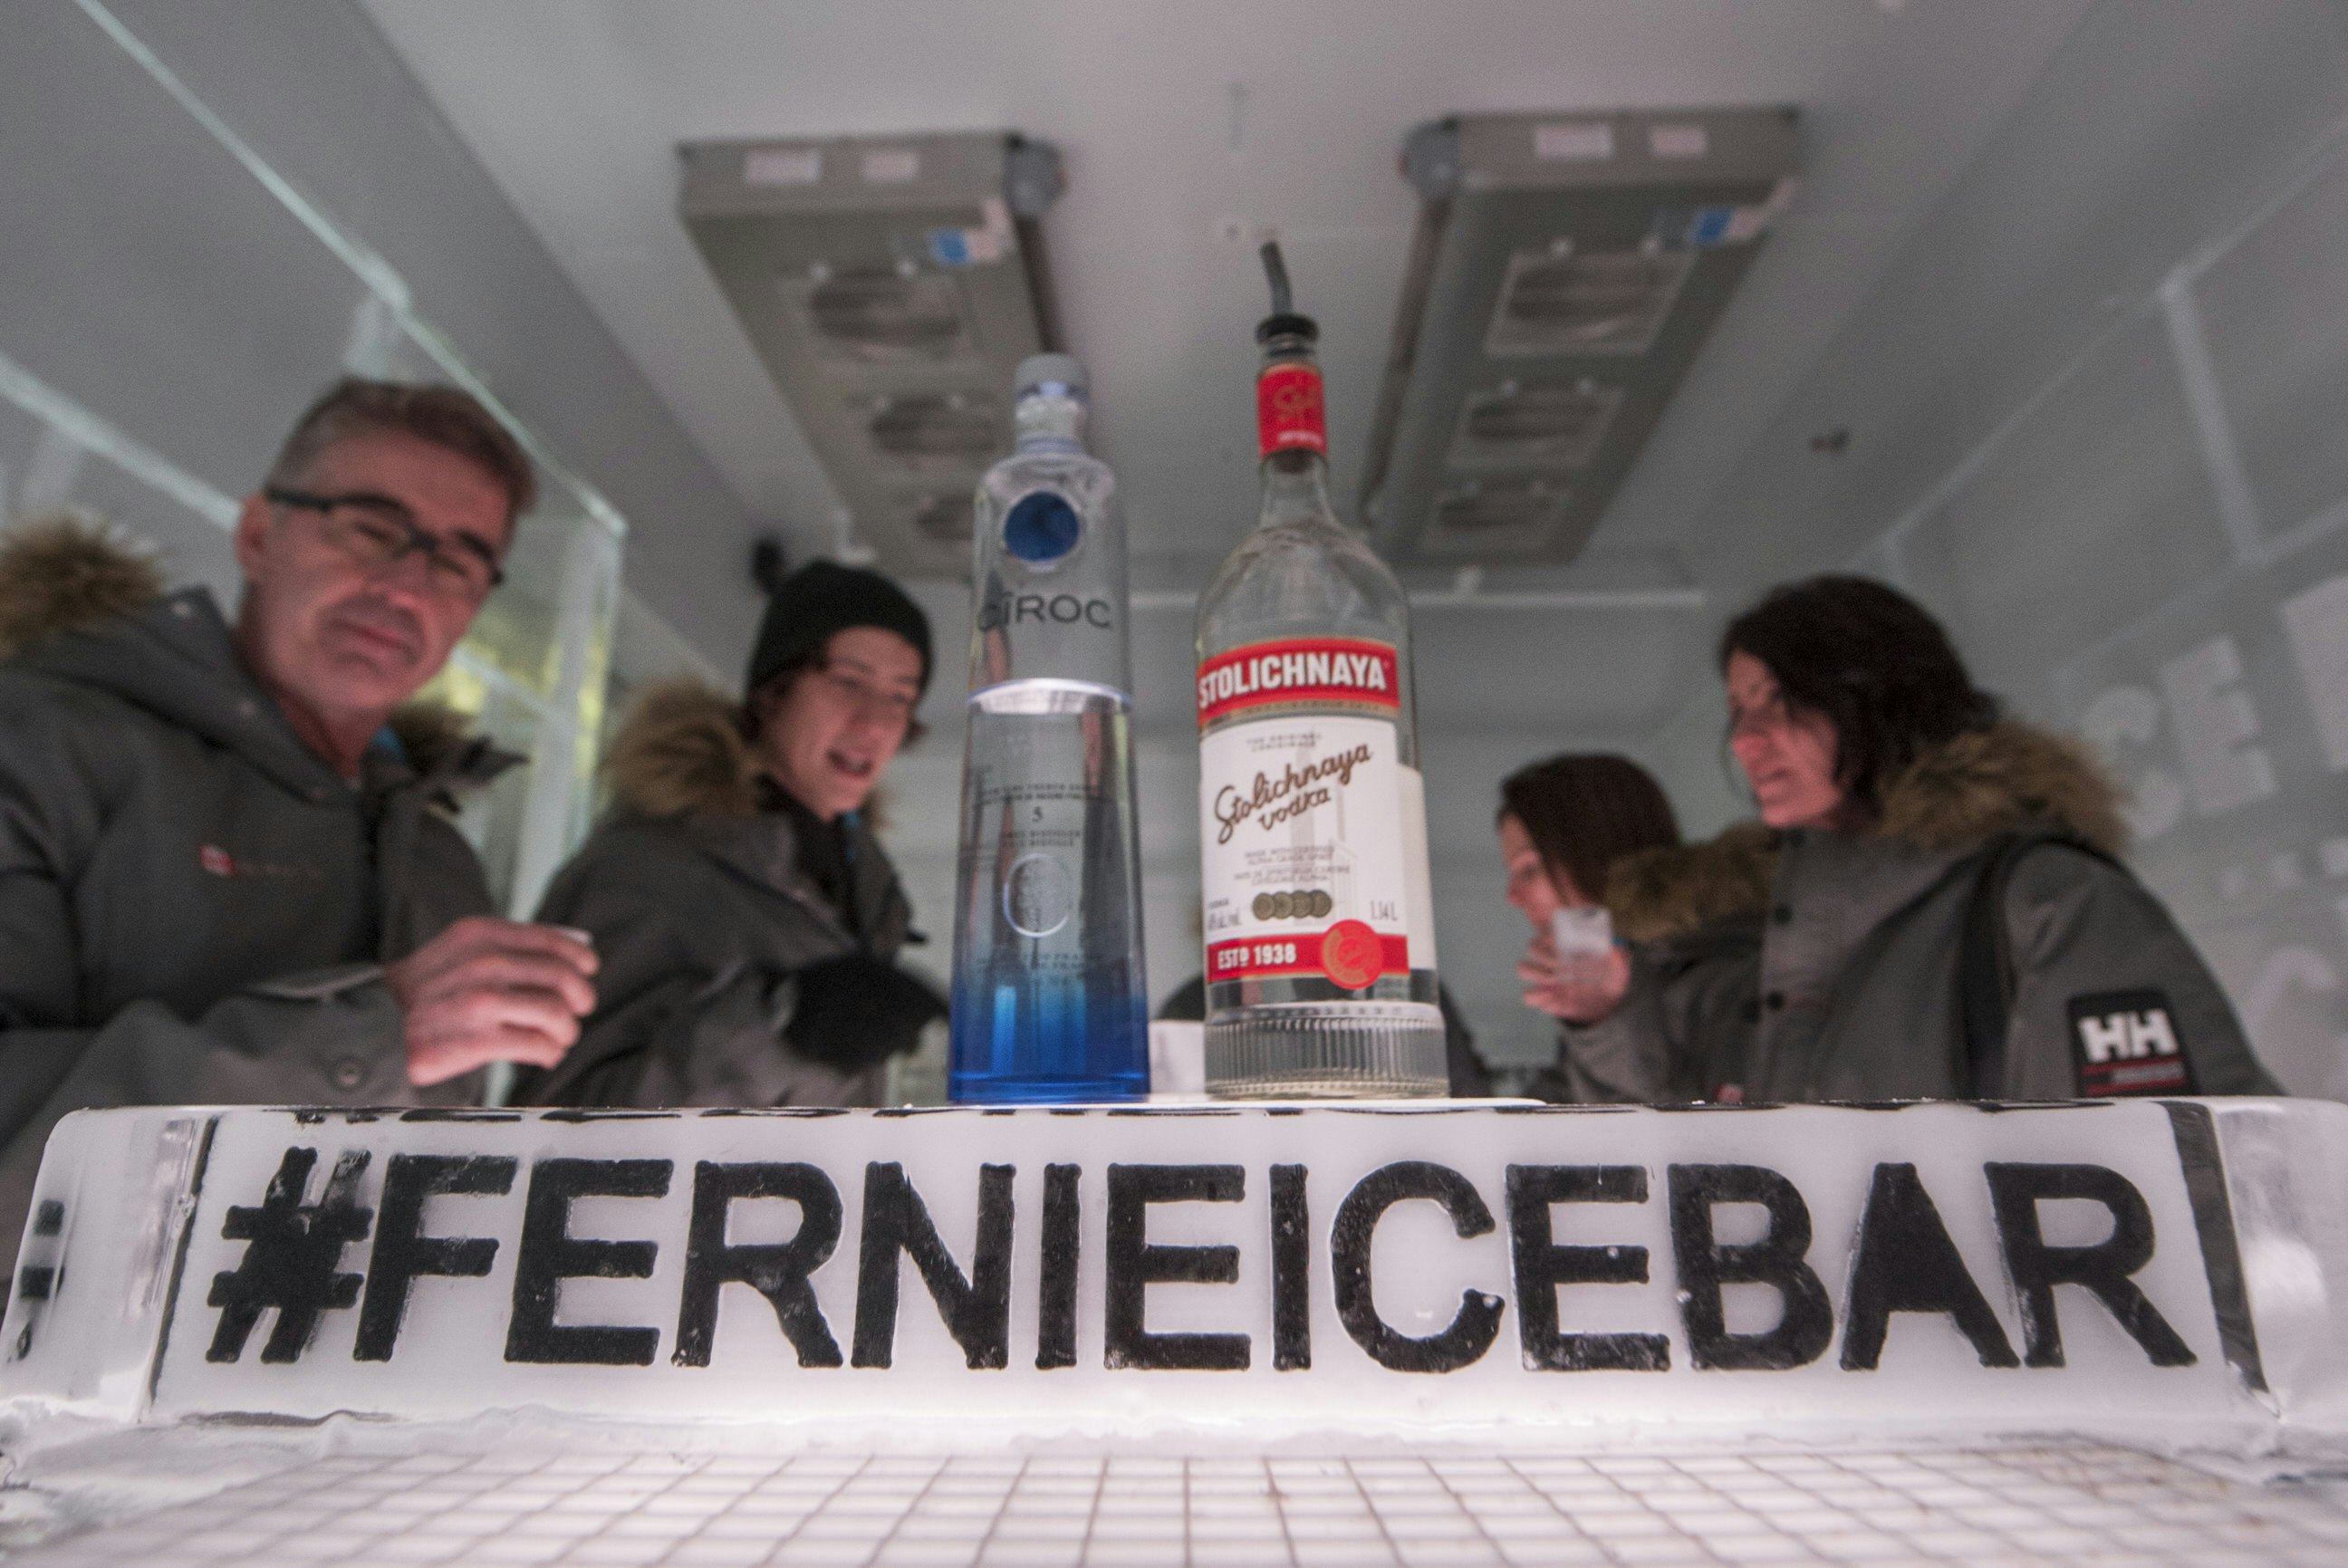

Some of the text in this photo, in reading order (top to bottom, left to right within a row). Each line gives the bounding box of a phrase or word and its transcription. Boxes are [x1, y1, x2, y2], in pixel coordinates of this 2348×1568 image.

[1198, 651, 1388, 710] STOLICHNAYA
[1214, 744, 1373, 844] Stolichnaya
[1257, 786, 1332, 831] vodka
[1254, 942, 1297, 967] 1938
[2077, 1006, 2179, 1063] HH
[206, 1146, 2199, 1374] #FERNIEICEBAR
